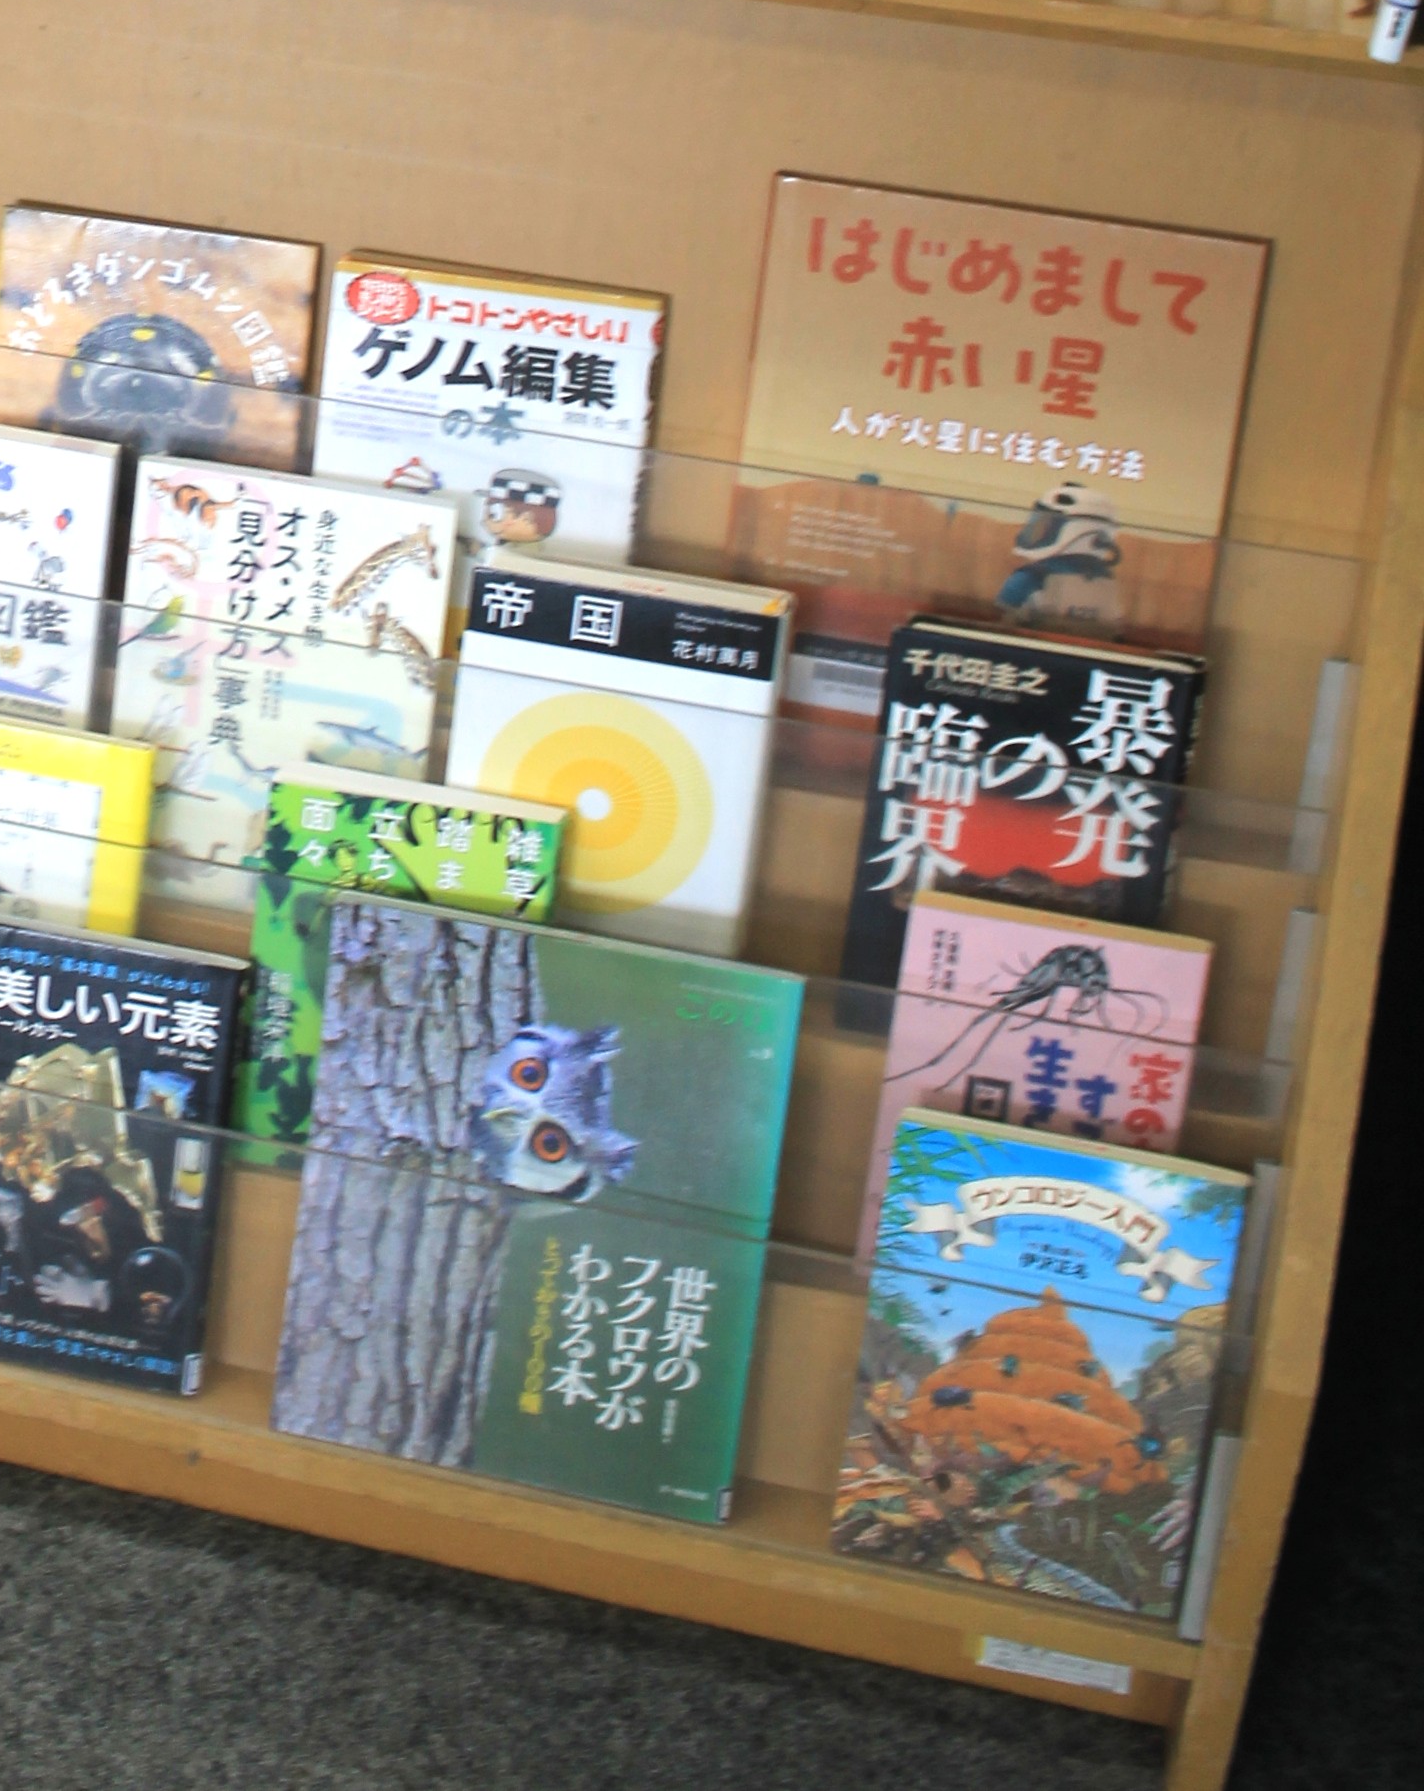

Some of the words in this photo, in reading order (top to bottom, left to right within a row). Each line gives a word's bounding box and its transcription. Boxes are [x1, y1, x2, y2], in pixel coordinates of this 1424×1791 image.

[807, 217, 1208, 336] はじめまして
[426, 296, 629, 343] トコトンやさしい
[354, 326, 617, 410] ゲノム編集
[881, 315, 1107, 421] 赤い星
[442, 401, 527, 446] の本
[830, 406, 1144, 482] 人が火星に住む方法
[261, 506, 308, 659] オス・メス
[305, 509, 338, 648] 身近な生き物
[481, 581, 625, 648] 帝国
[671, 639, 760, 670] 花村萬月
[904, 649, 1050, 696] 千代田圭之
[865, 701, 990, 892] 臨界
[980, 733, 1070, 801] の
[1050, 669, 1177, 879] 暴発
[502, 829, 544, 902] 雑草
[971, 1185, 1156, 1242] ウンコロジー入門
[544, 1243, 612, 1406] わかる本
[594, 1256, 661, 1432] フクロウが
[653, 1266, 719, 1393] 世界の
